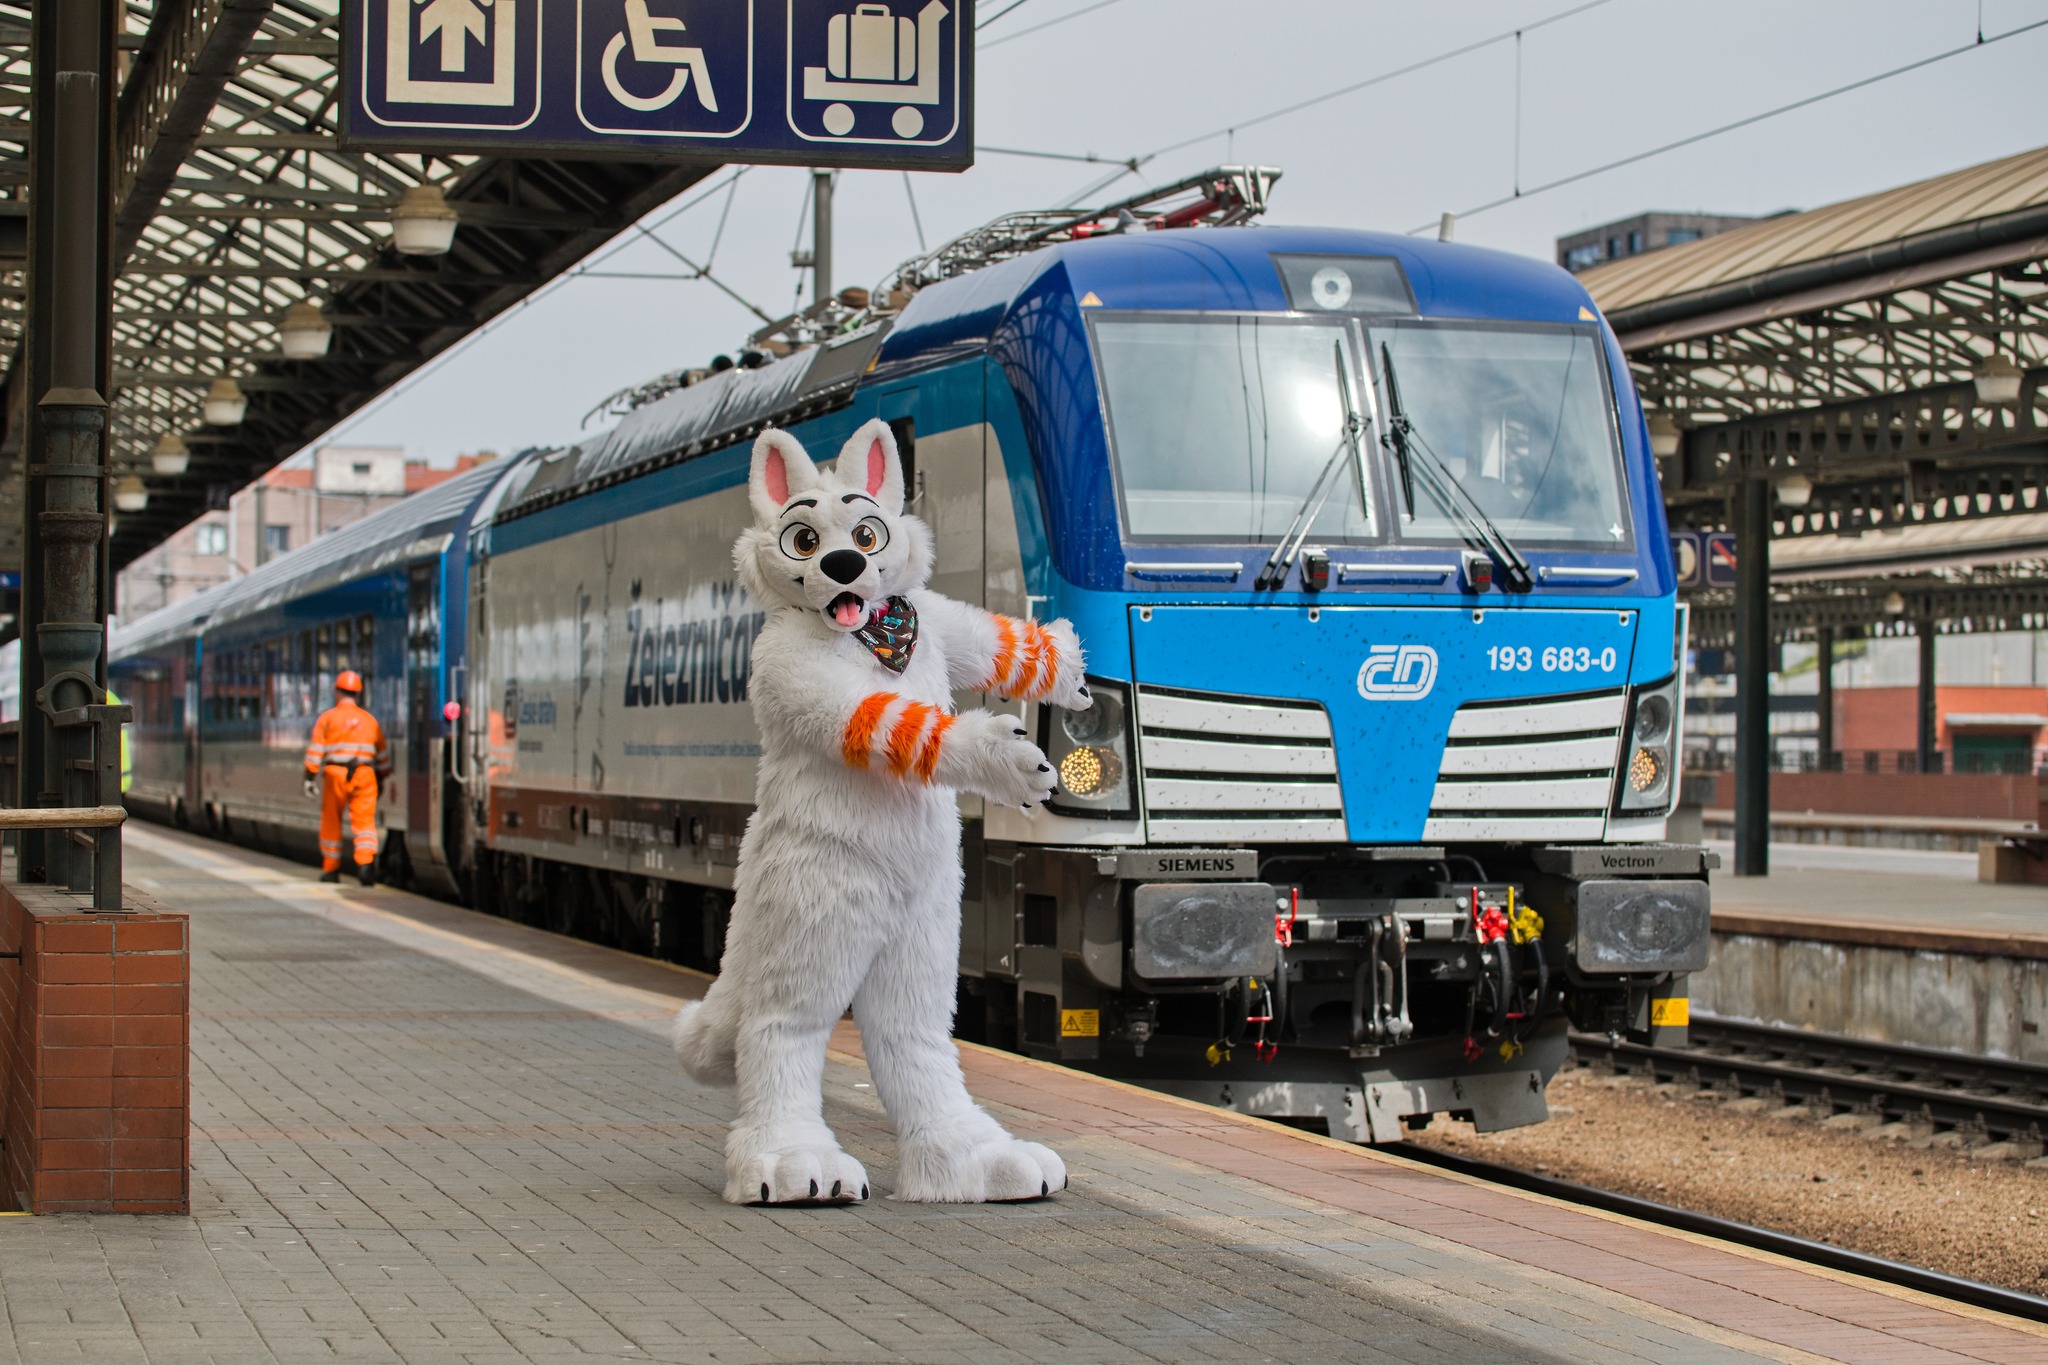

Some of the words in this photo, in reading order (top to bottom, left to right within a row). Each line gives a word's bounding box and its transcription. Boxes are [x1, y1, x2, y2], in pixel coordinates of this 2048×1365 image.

[1486, 645, 1533, 672] 193
[1541, 646, 1617, 673] 683-0
[1158, 858, 1235, 872] SIEMENS
[1601, 855, 1655, 868] Vectron
